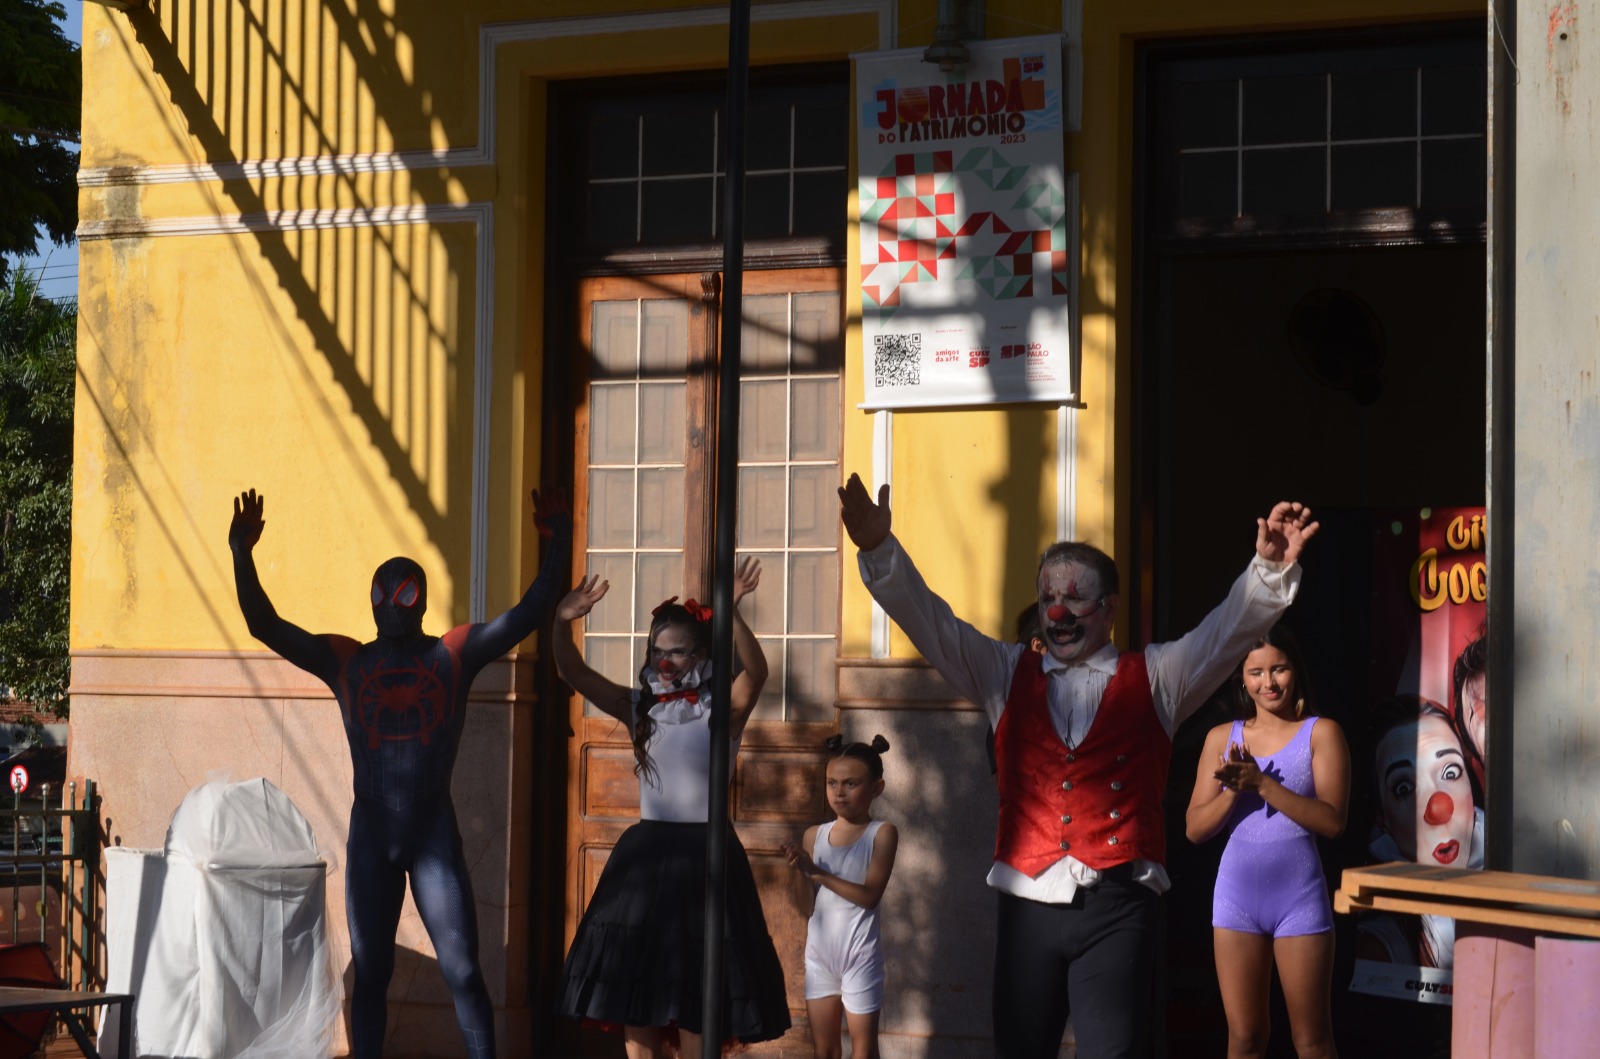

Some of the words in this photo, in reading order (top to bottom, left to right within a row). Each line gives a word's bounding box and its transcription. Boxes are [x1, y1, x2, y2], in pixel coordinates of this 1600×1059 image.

[1023, 62, 1044, 73] SP
[876, 78, 1026, 130] JORNADA
[878, 132, 897, 145] DO
[1000, 133, 1026, 145] 2023
[1027, 342, 1042, 350] SÃO
[936, 349, 960, 357] amigos
[969, 357, 990, 368] SP
